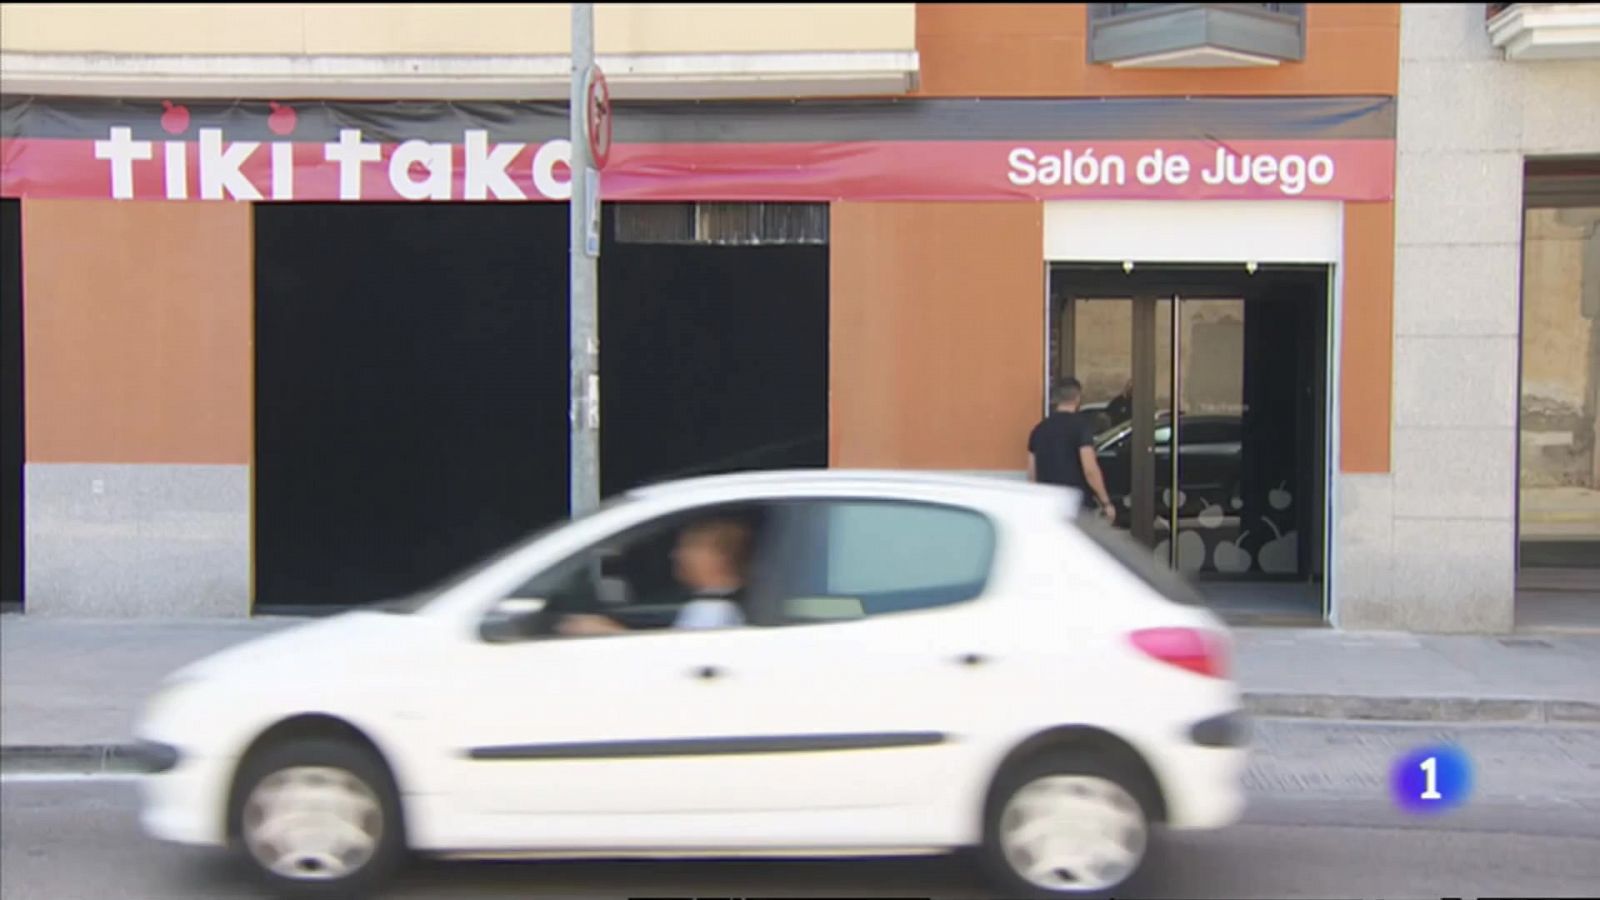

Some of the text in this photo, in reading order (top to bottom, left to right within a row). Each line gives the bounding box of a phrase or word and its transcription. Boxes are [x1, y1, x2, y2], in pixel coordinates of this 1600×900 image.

[95, 101, 296, 200] tiki
[1007, 147, 1335, 195] Salón de Juego
